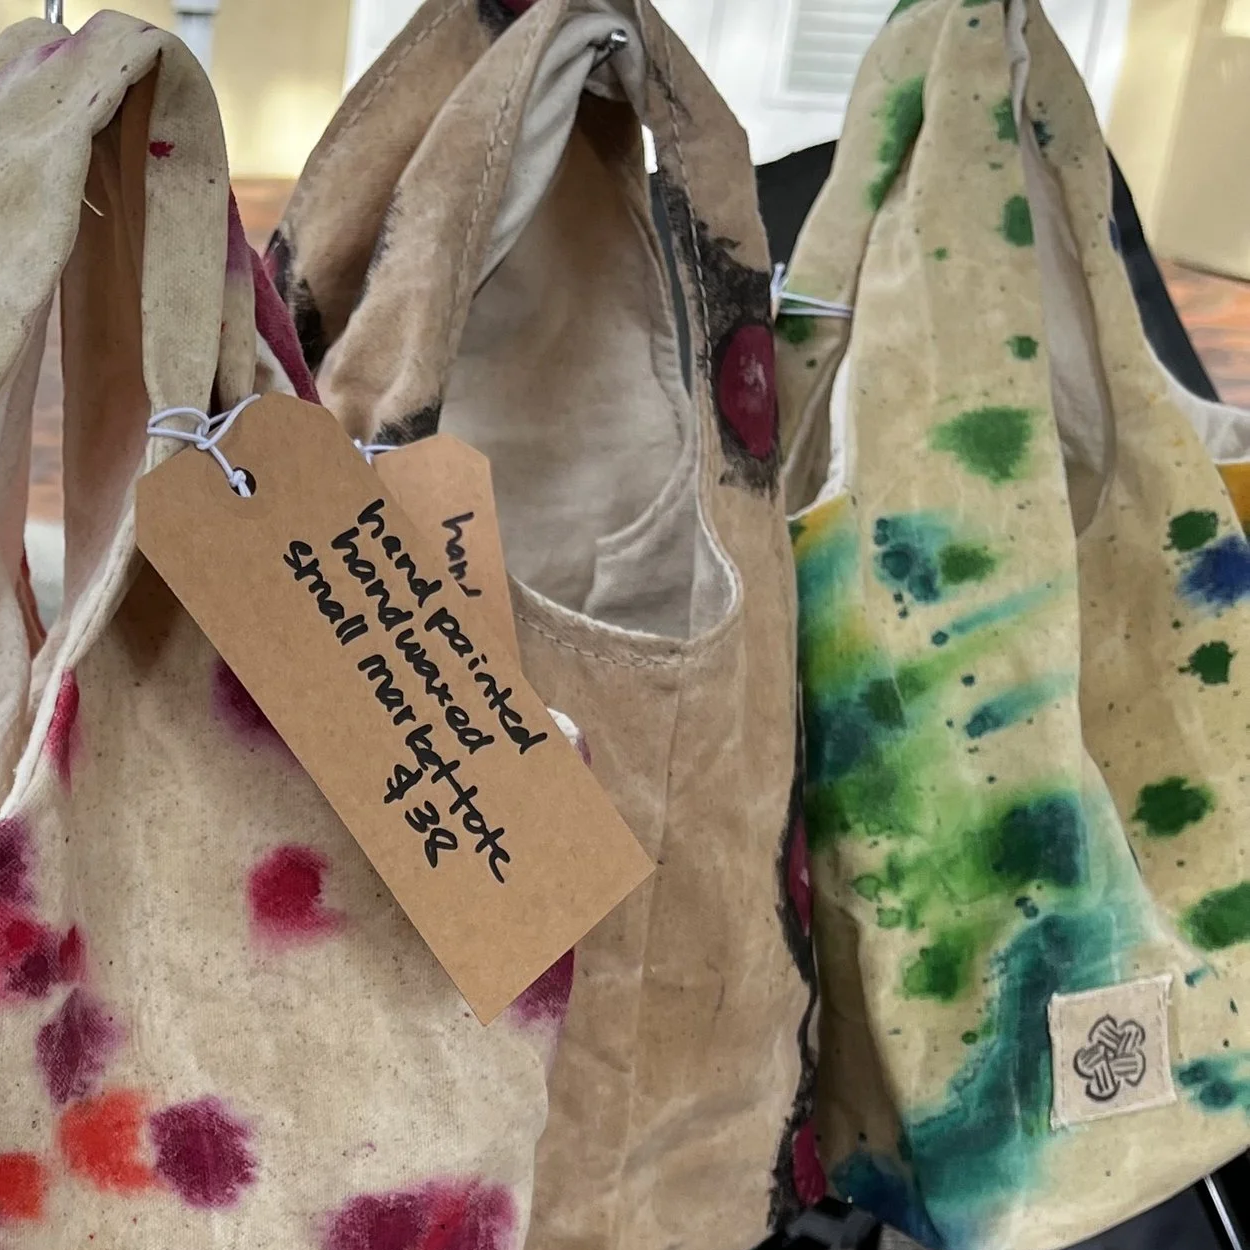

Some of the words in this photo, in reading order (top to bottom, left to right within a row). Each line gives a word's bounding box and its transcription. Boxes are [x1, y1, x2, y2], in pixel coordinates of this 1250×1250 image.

[283, 540, 369, 646] small
[357, 653, 461, 785] market
[448, 784, 511, 884] tote
[356, 498, 443, 609] hand
[423, 606, 548, 755] painted
